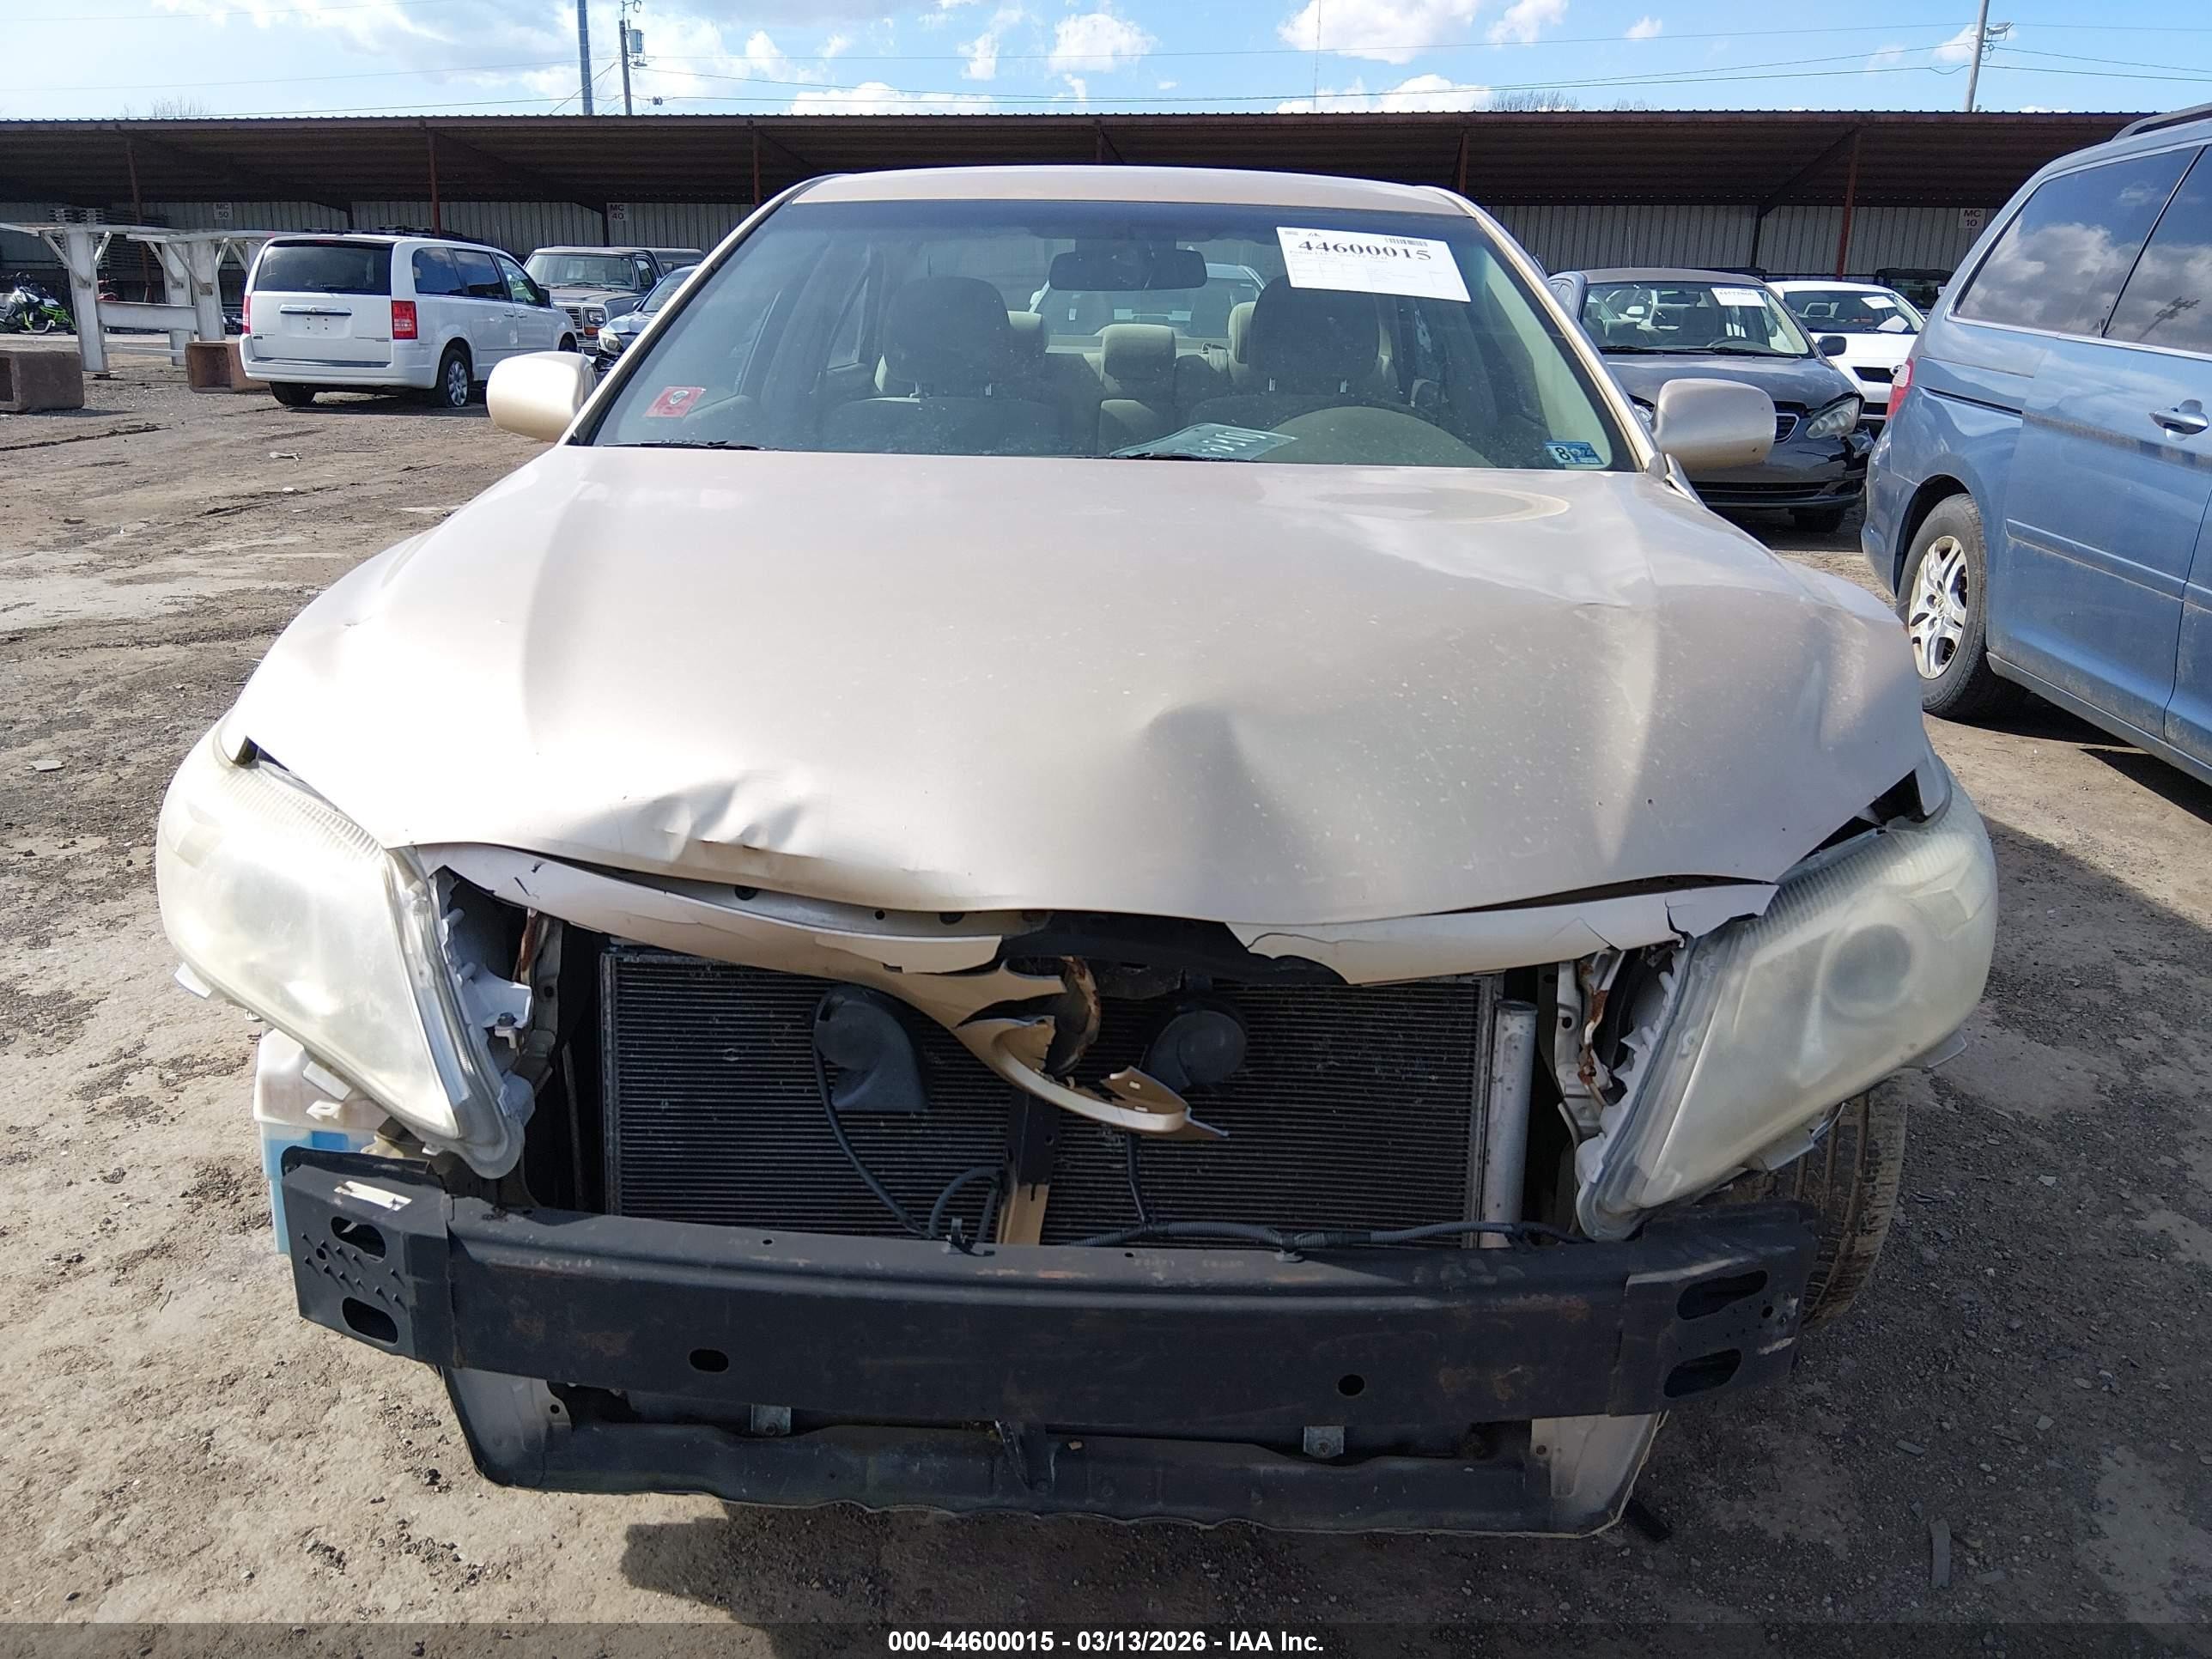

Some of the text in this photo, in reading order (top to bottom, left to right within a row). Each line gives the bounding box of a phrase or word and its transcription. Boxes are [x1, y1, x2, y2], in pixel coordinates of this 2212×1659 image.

[1964, 209, 1981, 217] MC
[1298, 240, 1431, 261] 44600015
[1555, 447, 1571, 460] 8
